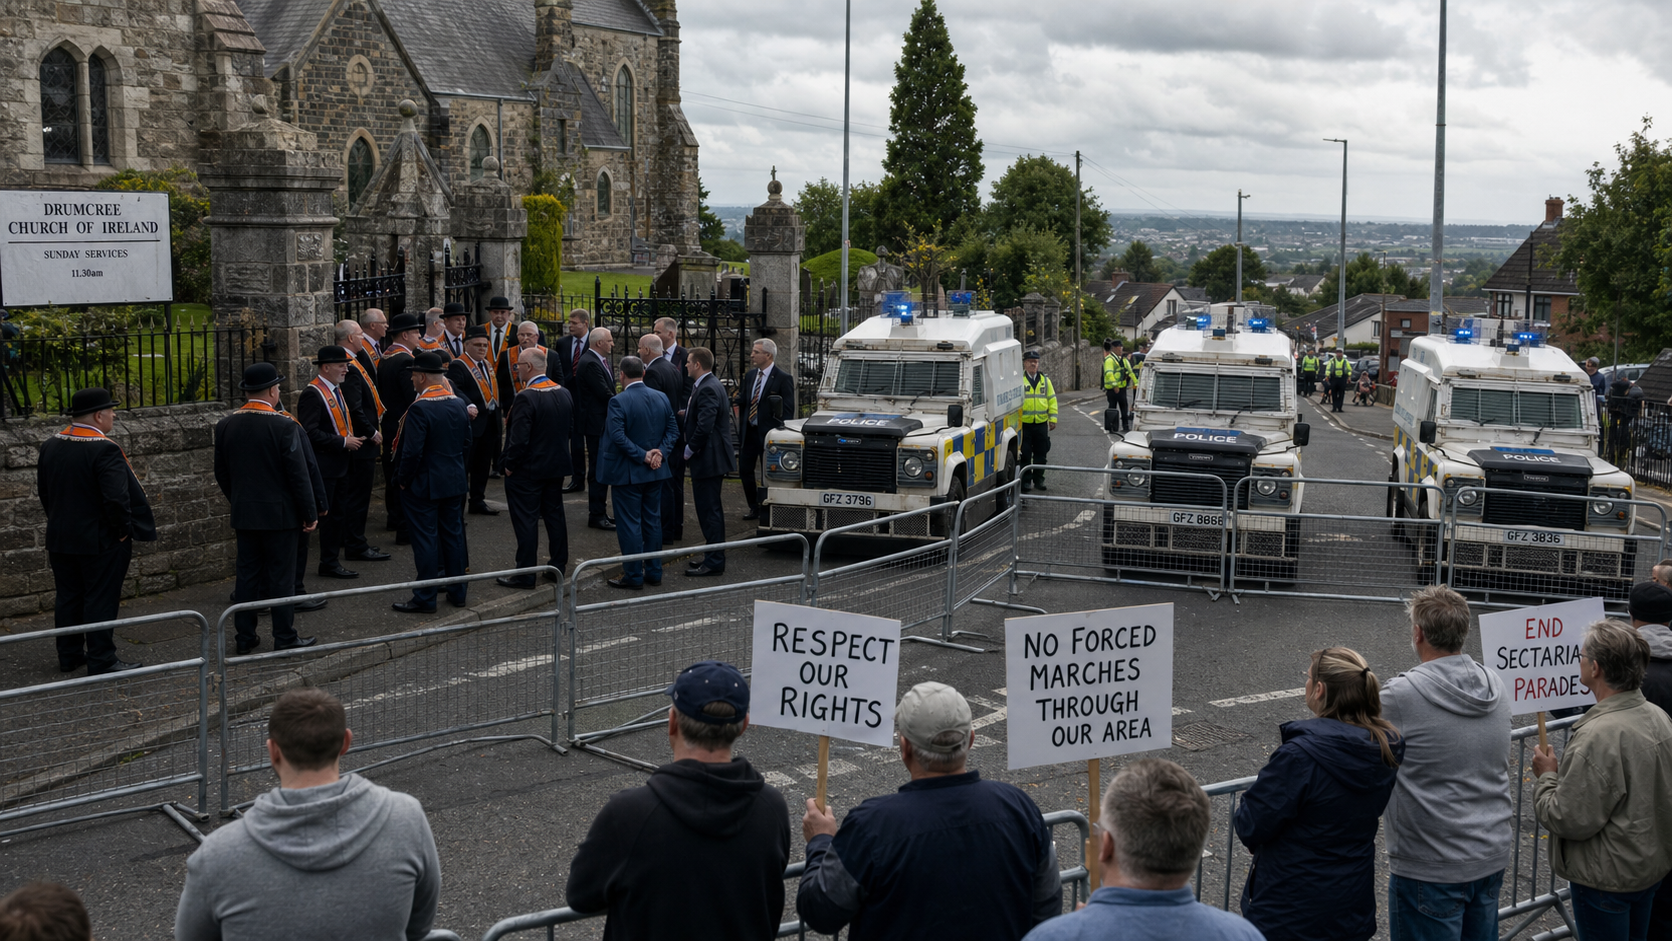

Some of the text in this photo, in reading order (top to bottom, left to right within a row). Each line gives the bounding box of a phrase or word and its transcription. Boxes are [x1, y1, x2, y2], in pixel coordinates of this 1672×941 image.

[44, 203, 122, 216] DRUMCREE
[8, 221, 159, 235] CHURCH OF IRELAND
[44, 249, 129, 259] SUNDAY SERVICES
[71, 268, 104, 278] 11.30am
[826, 417, 891, 427] POLICE
[1173, 432, 1237, 444] POLICE
[1503, 453, 1562, 464] POLICE
[823, 493, 872, 506] GFZ 3796
[1173, 512, 1194, 524] GFZ
[1507, 530, 1561, 544] GFZ 3836
[1525, 617, 1564, 640] END
[772, 622, 895, 664] RESPECT
[1024, 624, 1157, 659] NO FORCED
[1496, 644, 1582, 670] SECTARIA
[799, 661, 849, 689] OUR
[1030, 657, 1141, 692] MARCHES
[779, 686, 883, 729] RIGHTS
[1035, 689, 1140, 722] THROUGH
[1051, 716, 1152, 747] OUR AREA
